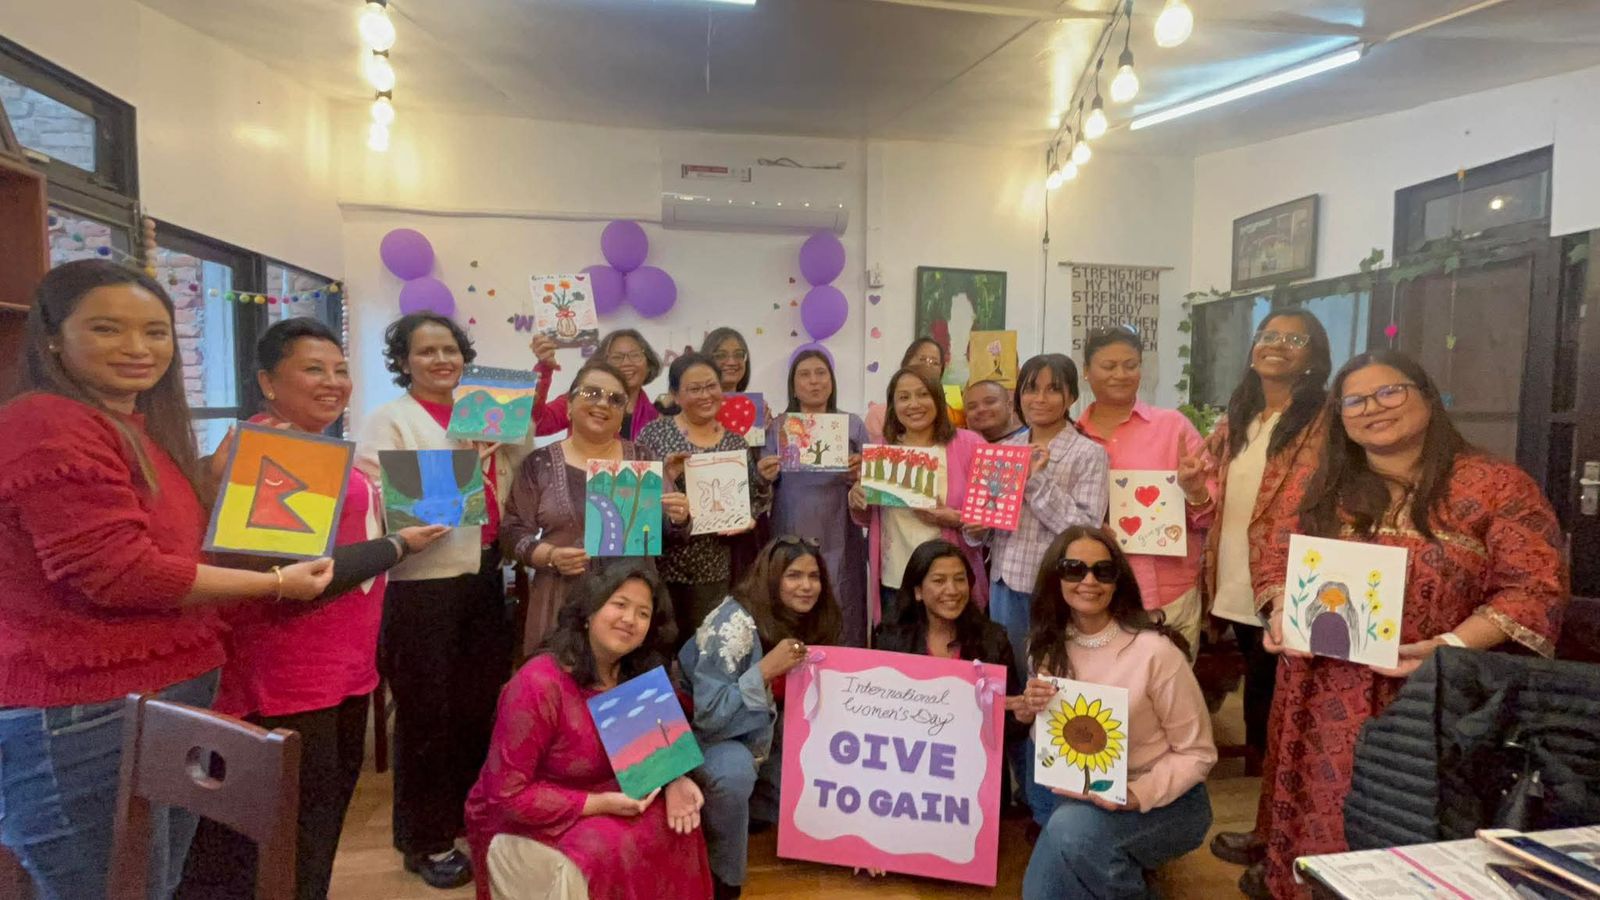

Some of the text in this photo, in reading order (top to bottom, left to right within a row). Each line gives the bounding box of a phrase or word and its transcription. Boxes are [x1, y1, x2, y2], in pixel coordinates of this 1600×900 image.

[1072, 266, 1160, 281] STRENGTHEN
[1085, 279, 1143, 292] MY MIND
[1072, 291, 1160, 305] STRENGTHEN
[1086, 303, 1143, 316] MY BODY
[841, 676, 950, 705] International
[842, 697, 955, 736] Women's Day
[829, 731, 957, 780] GIVE
[813, 778, 970, 825] TO GAIN
